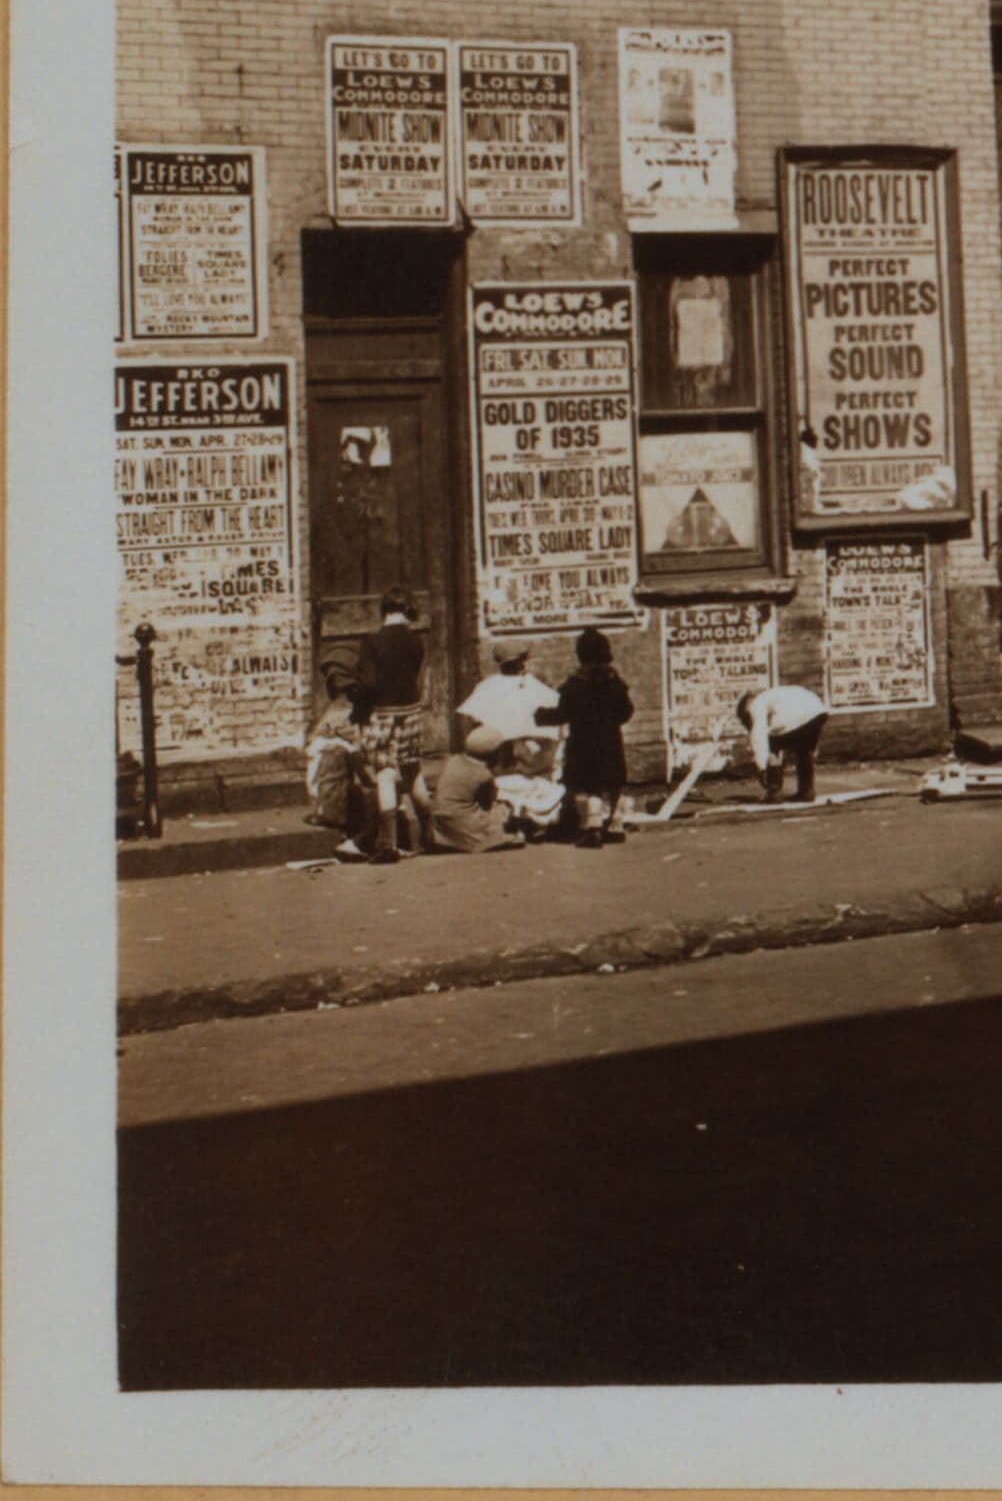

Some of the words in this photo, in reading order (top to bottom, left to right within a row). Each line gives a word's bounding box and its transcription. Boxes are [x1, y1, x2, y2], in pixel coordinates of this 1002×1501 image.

[389, 52, 410, 69] GO
[418, 53, 437, 70] TO
[515, 54, 535, 70] GO
[543, 56, 561, 71] TO
[334, 86, 447, 104] COMMODORE
[461, 87, 569, 105] COMMODORE
[131, 160, 249, 184] JEFFERSON
[339, 155, 441, 173] SATURDAY
[468, 155, 566, 172] SATURDAY
[803, 174, 929, 225] ROOSEVELT
[829, 259, 911, 277] PERFECT
[806, 280, 938, 319] PICTURES
[475, 299, 631, 333] COMMODORE
[834, 323, 915, 343] PERFECT
[828, 345, 924, 381] SOUND
[177, 368, 221, 380] RKO
[488, 377, 526, 388] APRIL
[115, 373, 281, 415] JEFFERSON
[835, 391, 917, 411] PERFECT
[484, 401, 536, 426] GOLD
[545, 398, 628, 423] DIGGERS
[516, 427, 542, 450] OF
[551, 425, 600, 449] 1935
[822, 413, 932, 451] SHOWS
[486, 471, 535, 502] CASINO
[540, 467, 596, 499] MURDER
[599, 465, 633, 497] CASE
[122, 491, 178, 505] WOMAN
[184, 490, 198, 502] IN
[205, 489, 233, 501] THE
[239, 487, 278, 500] DARK
[116, 511, 174, 536] STRAIGHT
[181, 509, 215, 532] FROM
[221, 507, 242, 531] THE
[248, 504, 284, 529] HEART
[489, 532, 532, 558] TIMES
[538, 528, 593, 554] SQUARE
[598, 526, 632, 550] LADY
[827, 556, 923, 570] COMMODORE
[559, 571, 581, 589] YOU
[586, 567, 630, 587] ALWAYS
[719, 664, 767, 677] TALKING
